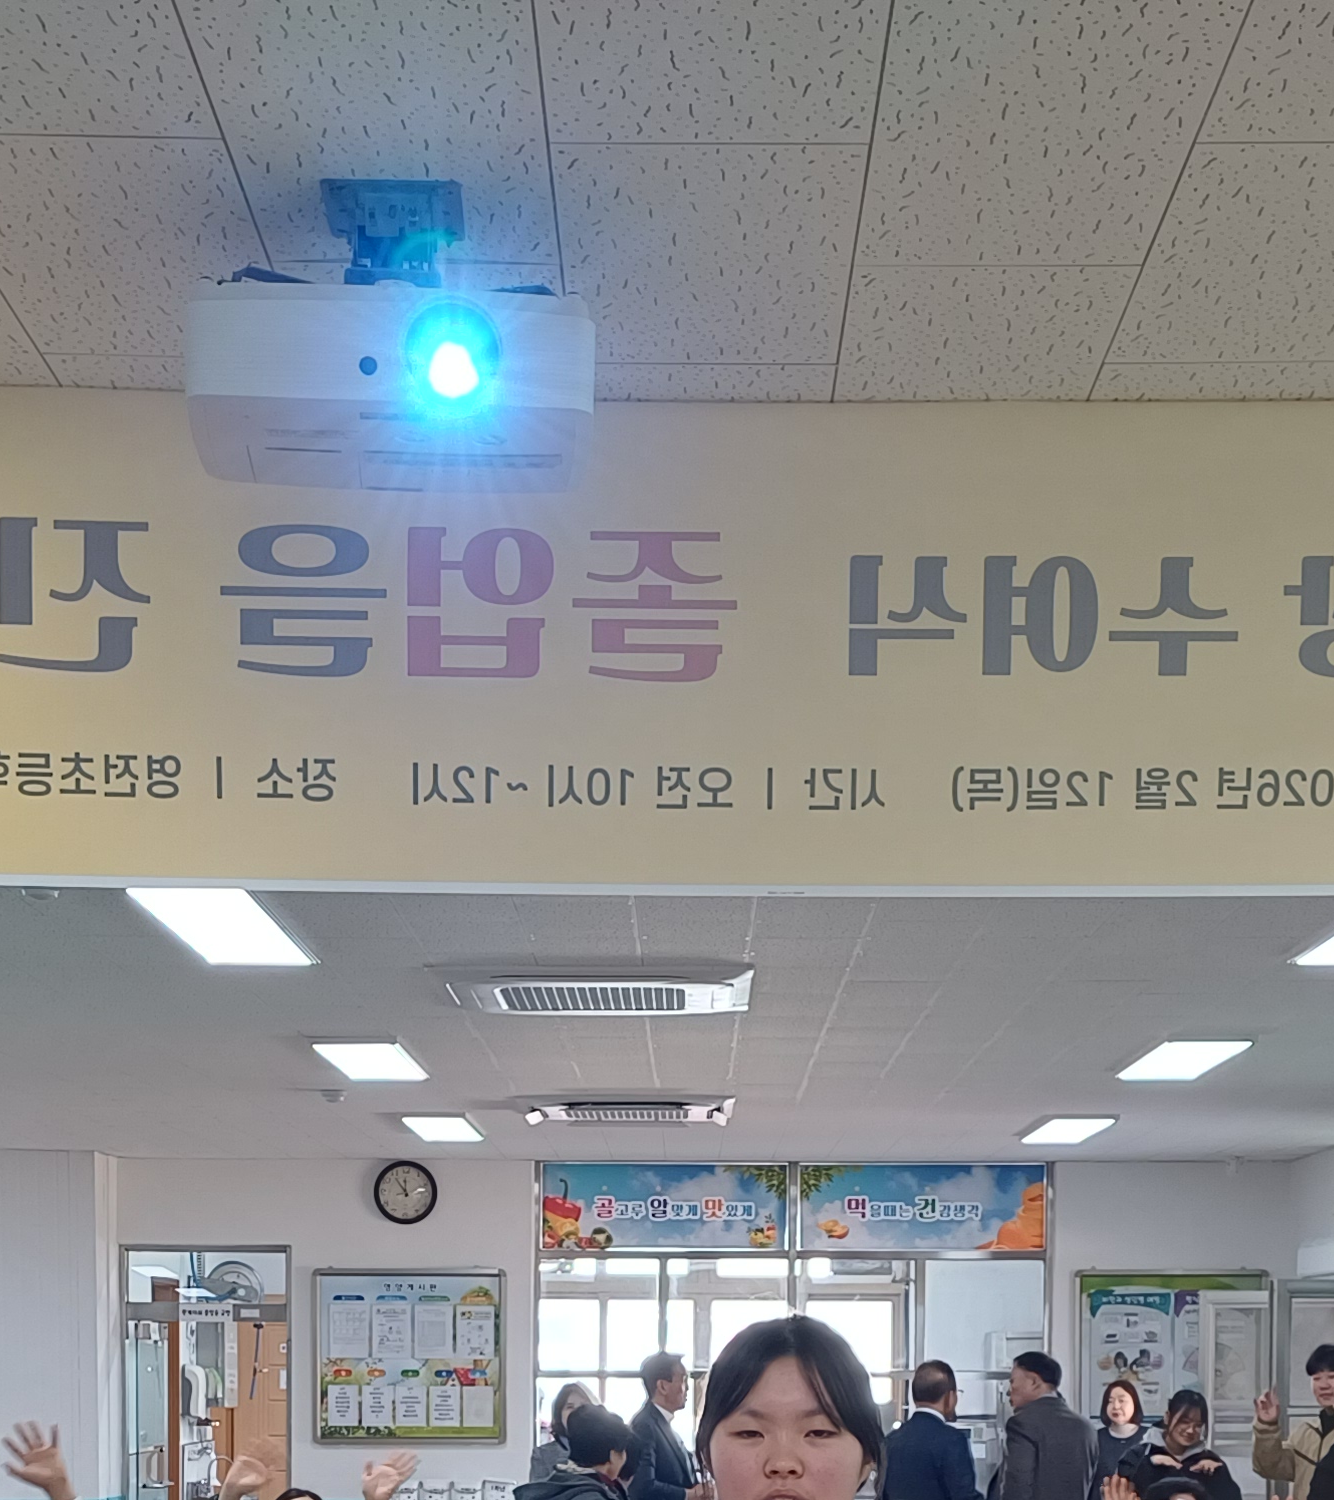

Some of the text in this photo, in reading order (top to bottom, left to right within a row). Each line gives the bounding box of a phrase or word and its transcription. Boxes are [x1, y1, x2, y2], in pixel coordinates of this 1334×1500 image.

[594, 1197, 754, 1220] 골고루 알맞게 맛있게
[846, 1197, 980, 1220] 먹을때는 건강생각
